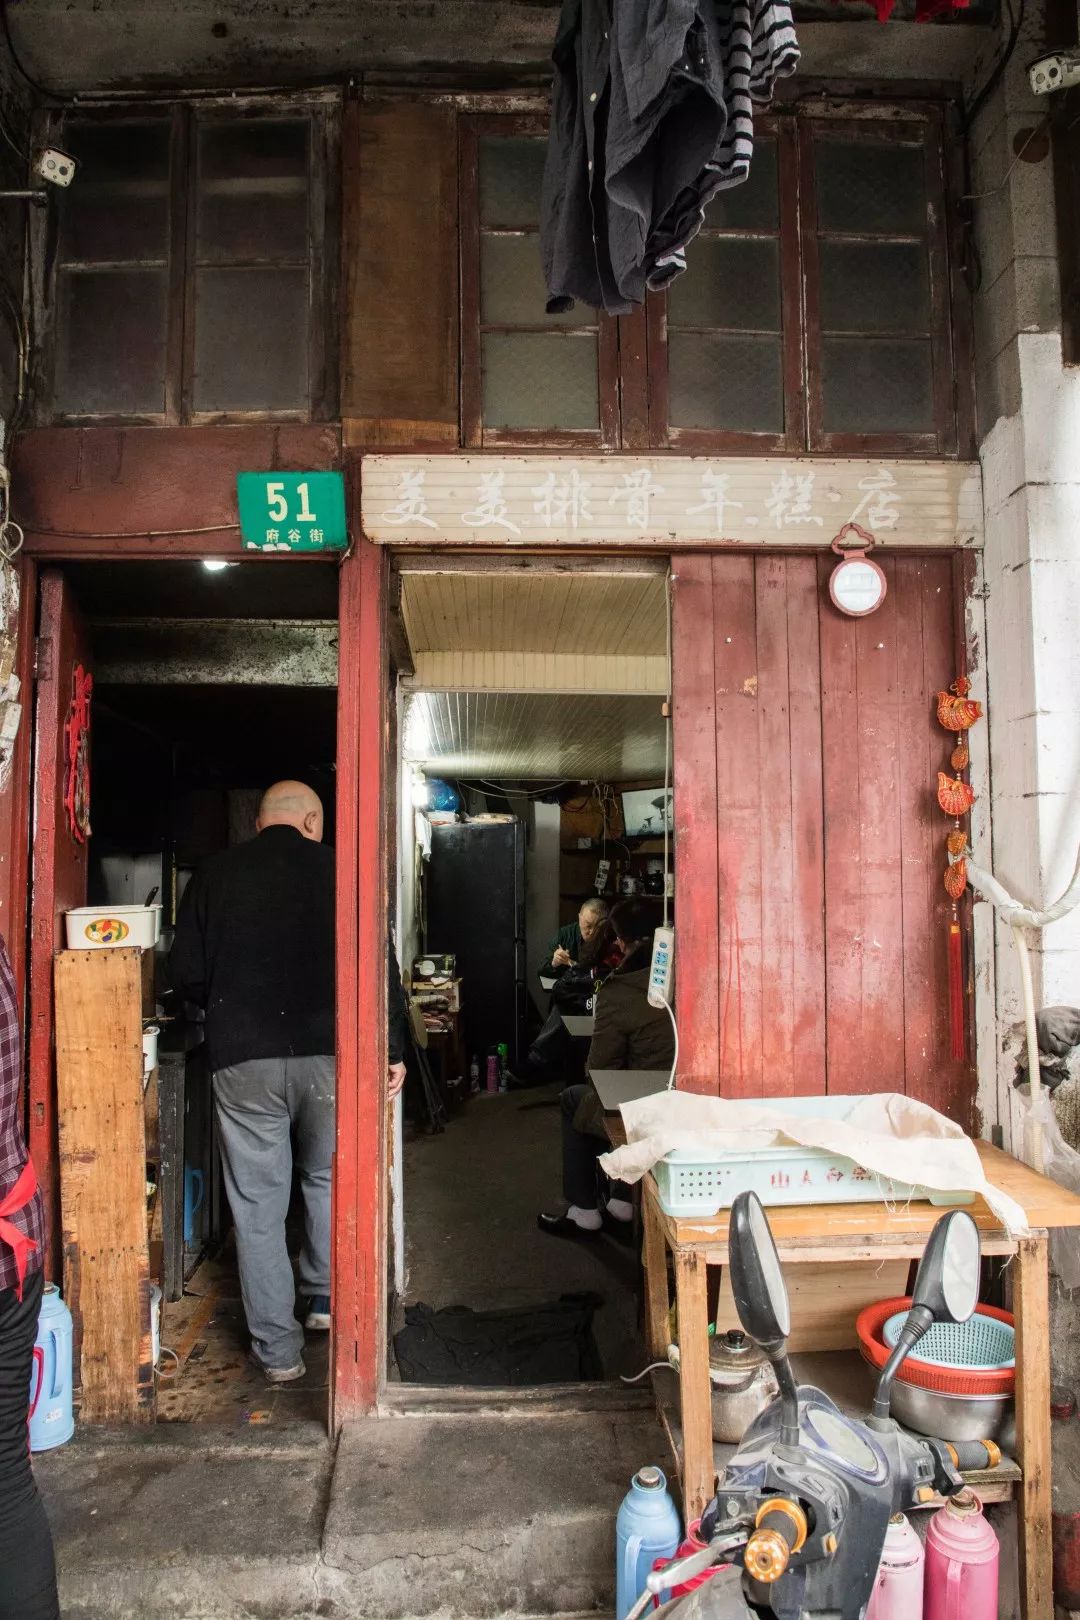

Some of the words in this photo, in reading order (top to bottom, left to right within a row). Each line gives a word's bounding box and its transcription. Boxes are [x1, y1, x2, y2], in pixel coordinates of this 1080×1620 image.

[266, 482, 317, 522] 51
[381, 467, 901, 534] 美美排骨年糕店
[265, 528, 324, 543] 府谷街
